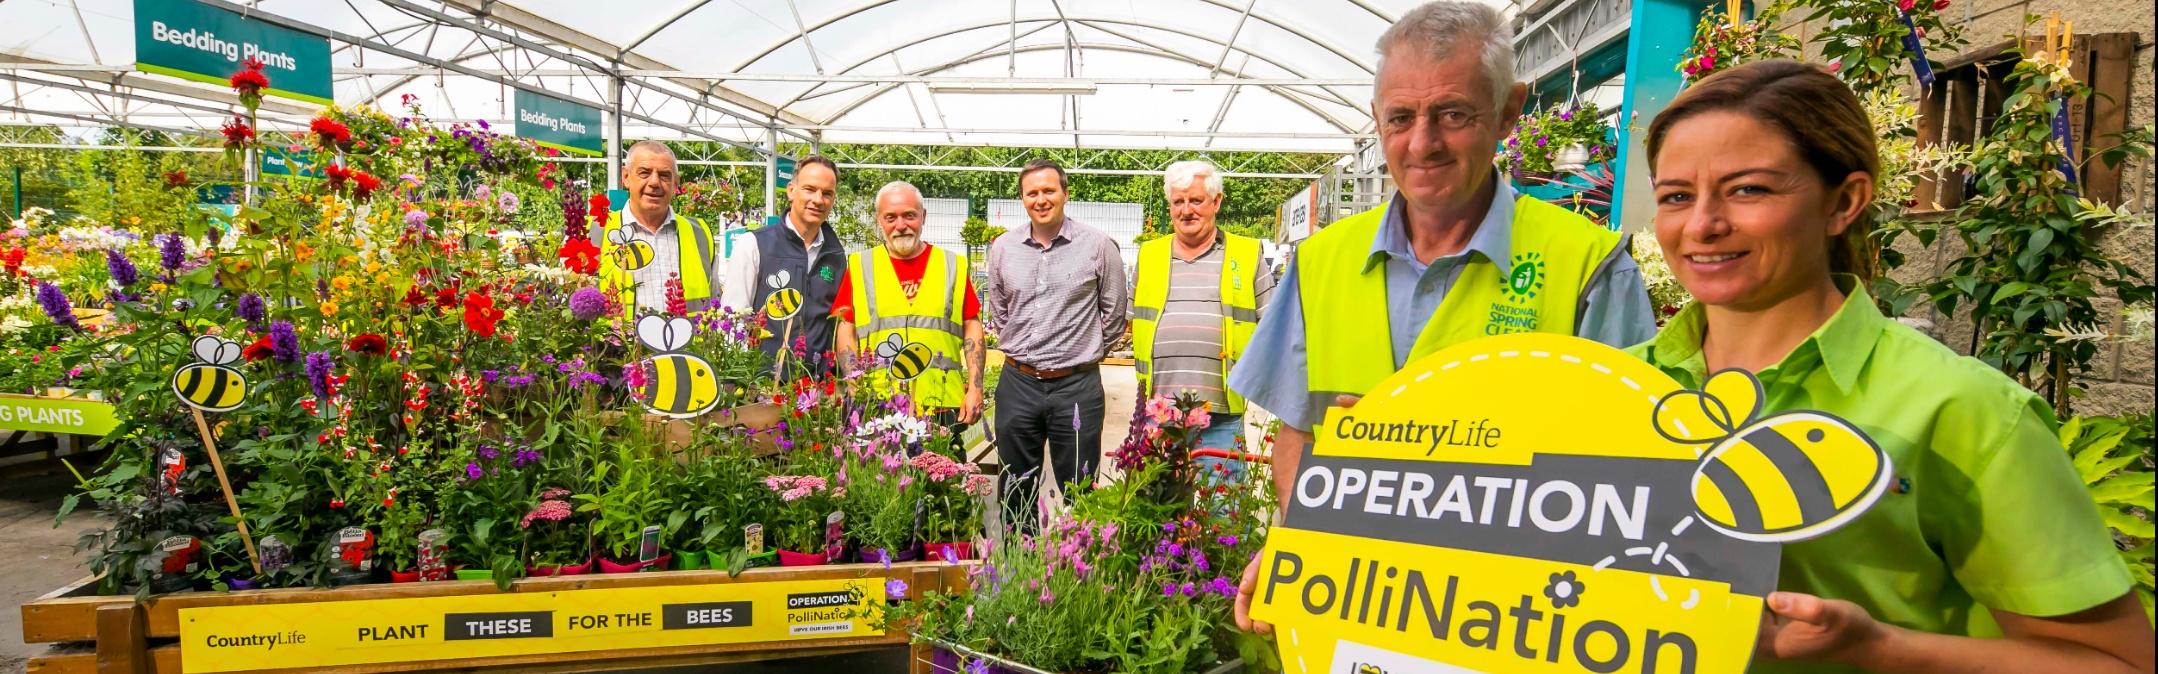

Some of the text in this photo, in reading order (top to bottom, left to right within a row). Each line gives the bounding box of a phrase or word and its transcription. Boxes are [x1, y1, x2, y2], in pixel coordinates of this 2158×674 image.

[152, 20, 296, 71] Bedding Plants
[520, 108, 586, 134] Bedding Plants
[1489, 311, 1537, 331] SPRING
[1491, 302, 1537, 318] NATIONAL
[16, 406, 84, 426] PLANTS
[1296, 465, 1651, 541] OPERATION
[789, 594, 848, 606] OPERATION
[1263, 549, 1699, 674] PolliNation
[358, 608, 733, 642] PLANT THESE FOR THE BEES
[787, 607, 848, 623] PolliNatio
